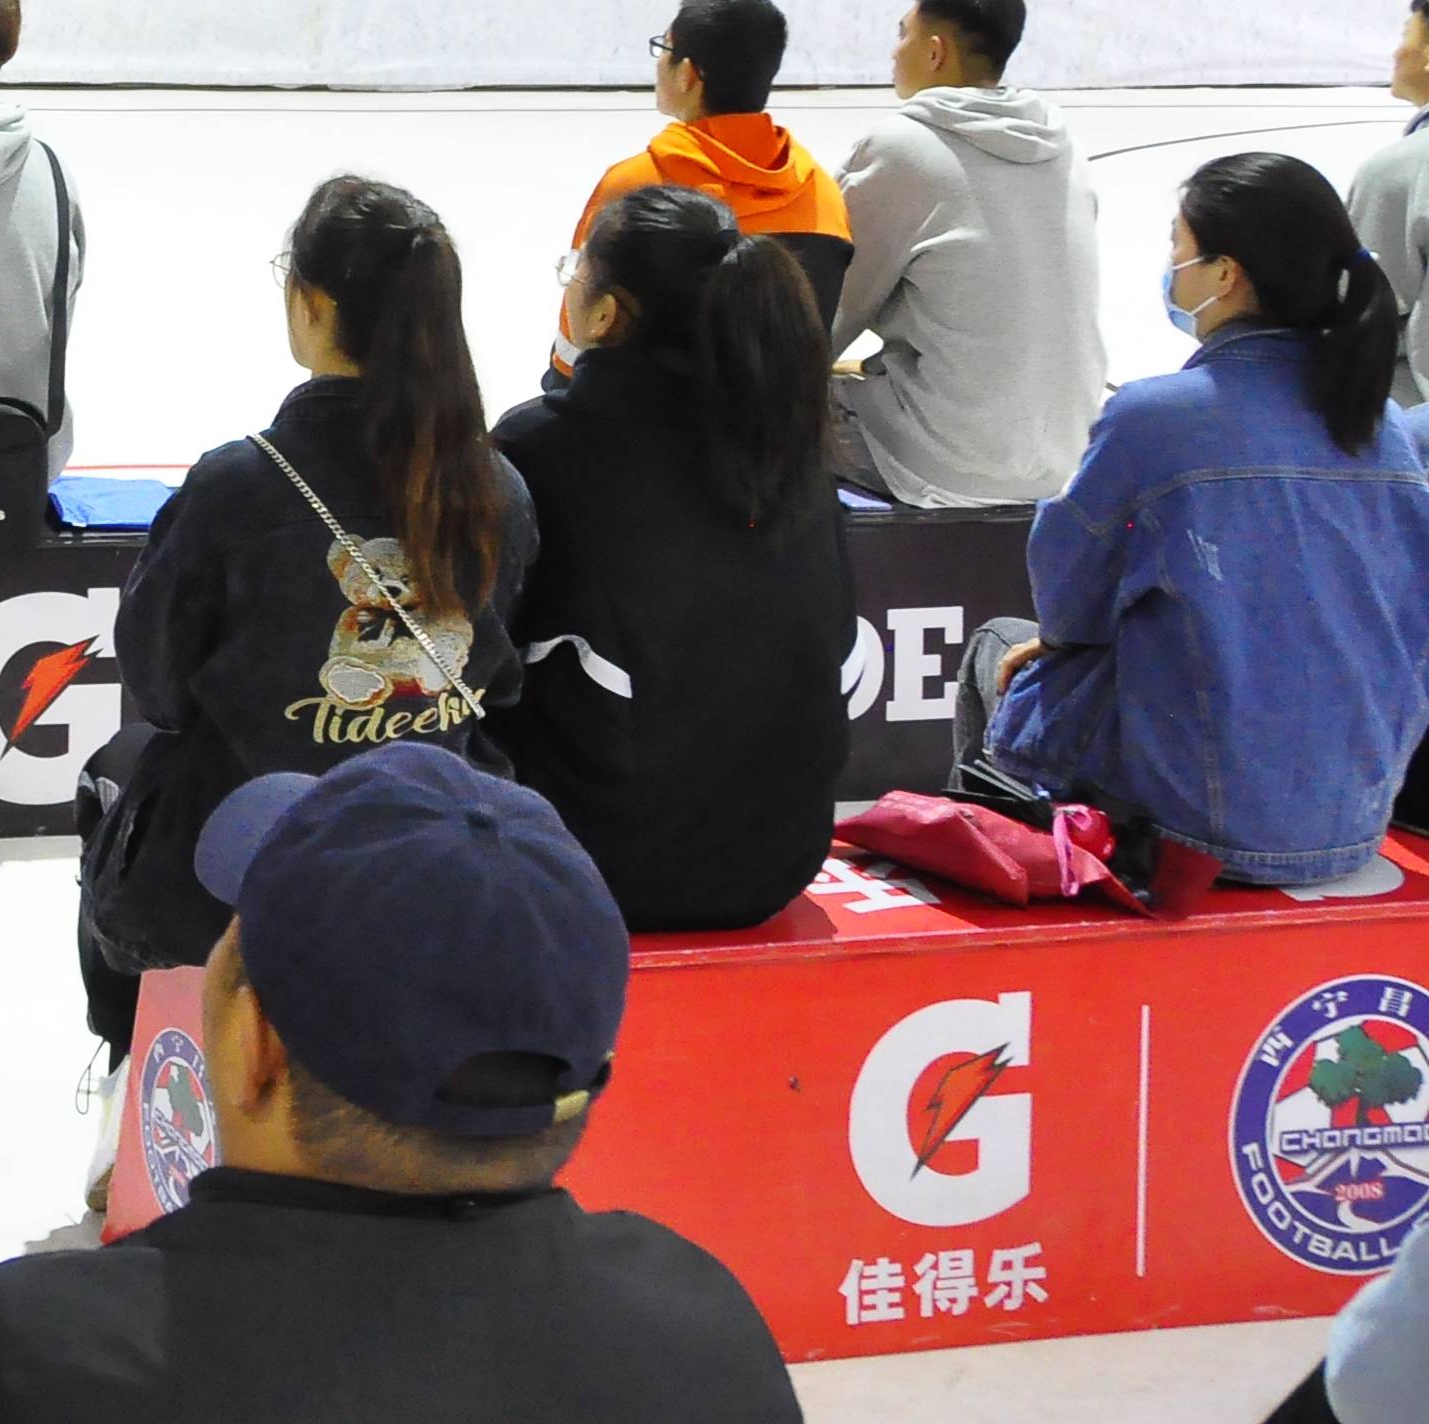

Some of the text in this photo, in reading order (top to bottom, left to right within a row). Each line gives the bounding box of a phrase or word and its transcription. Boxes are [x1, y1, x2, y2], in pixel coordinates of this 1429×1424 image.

[848, 990, 1032, 1228] G
[1242, 1141, 1403, 1263] FOOTBALL
[1334, 1180, 1385, 1203] 2008
[838, 1243, 1048, 1325] 佳得乐
